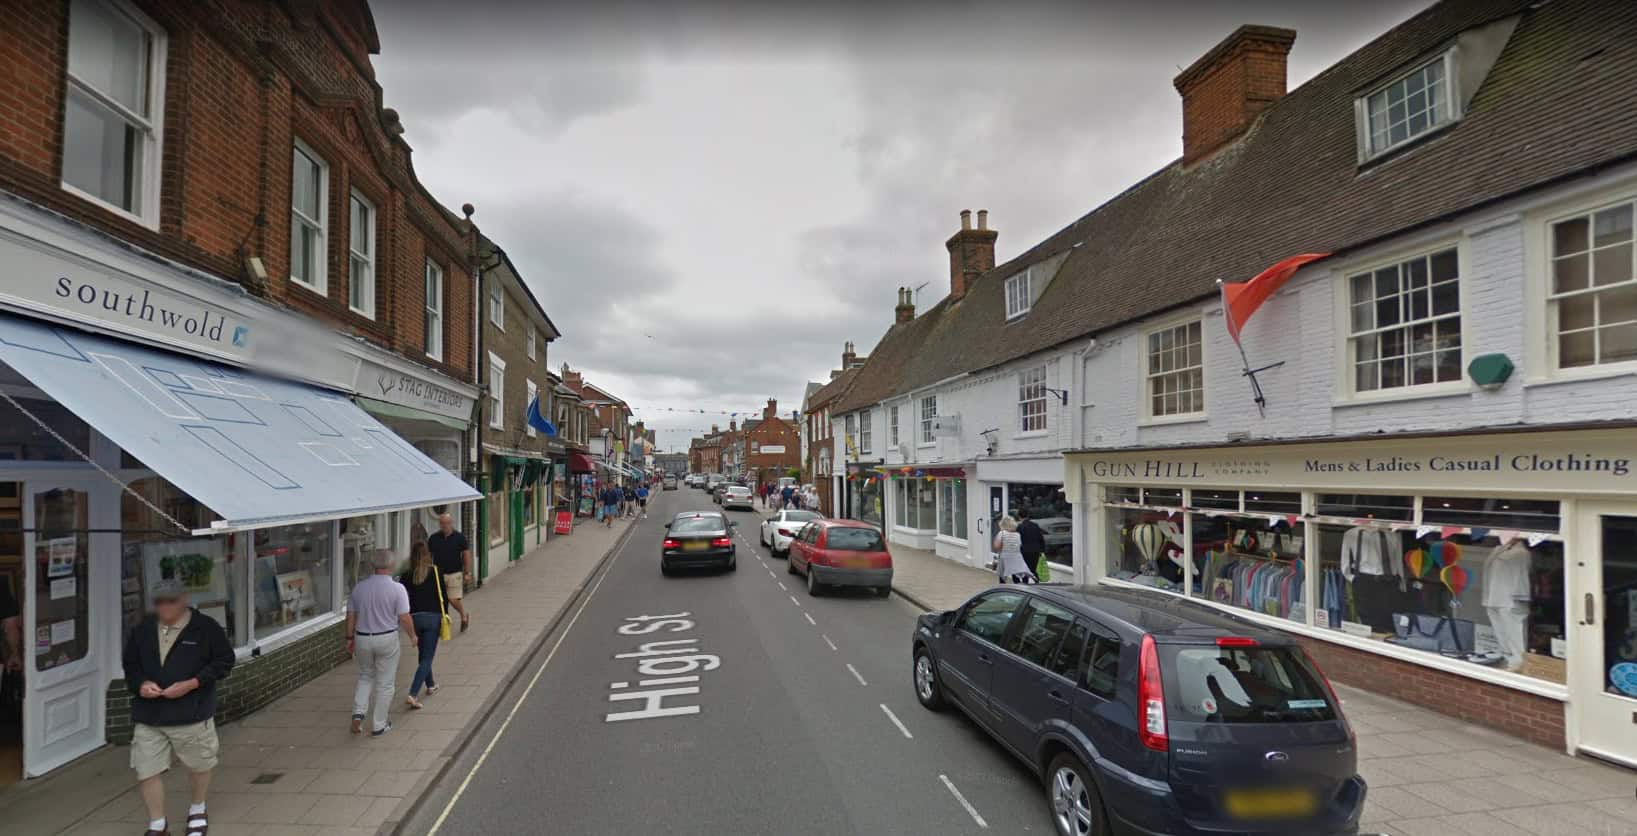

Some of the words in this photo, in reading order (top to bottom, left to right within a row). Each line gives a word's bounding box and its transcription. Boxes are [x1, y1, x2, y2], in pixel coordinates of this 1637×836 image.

[55, 277, 225, 342] southwold
[398, 377, 422, 397] STAG
[424, 385, 464, 409] INTERIORS
[1093, 461, 1137, 477] GUN
[1143, 460, 1205, 478] HILL
[1304, 459, 1344, 473] Mens
[1348, 461, 1361, 472] &
[1366, 457, 1421, 472] Ladies
[1429, 455, 1501, 472] Casual
[1511, 454, 1631, 476] Clothing
